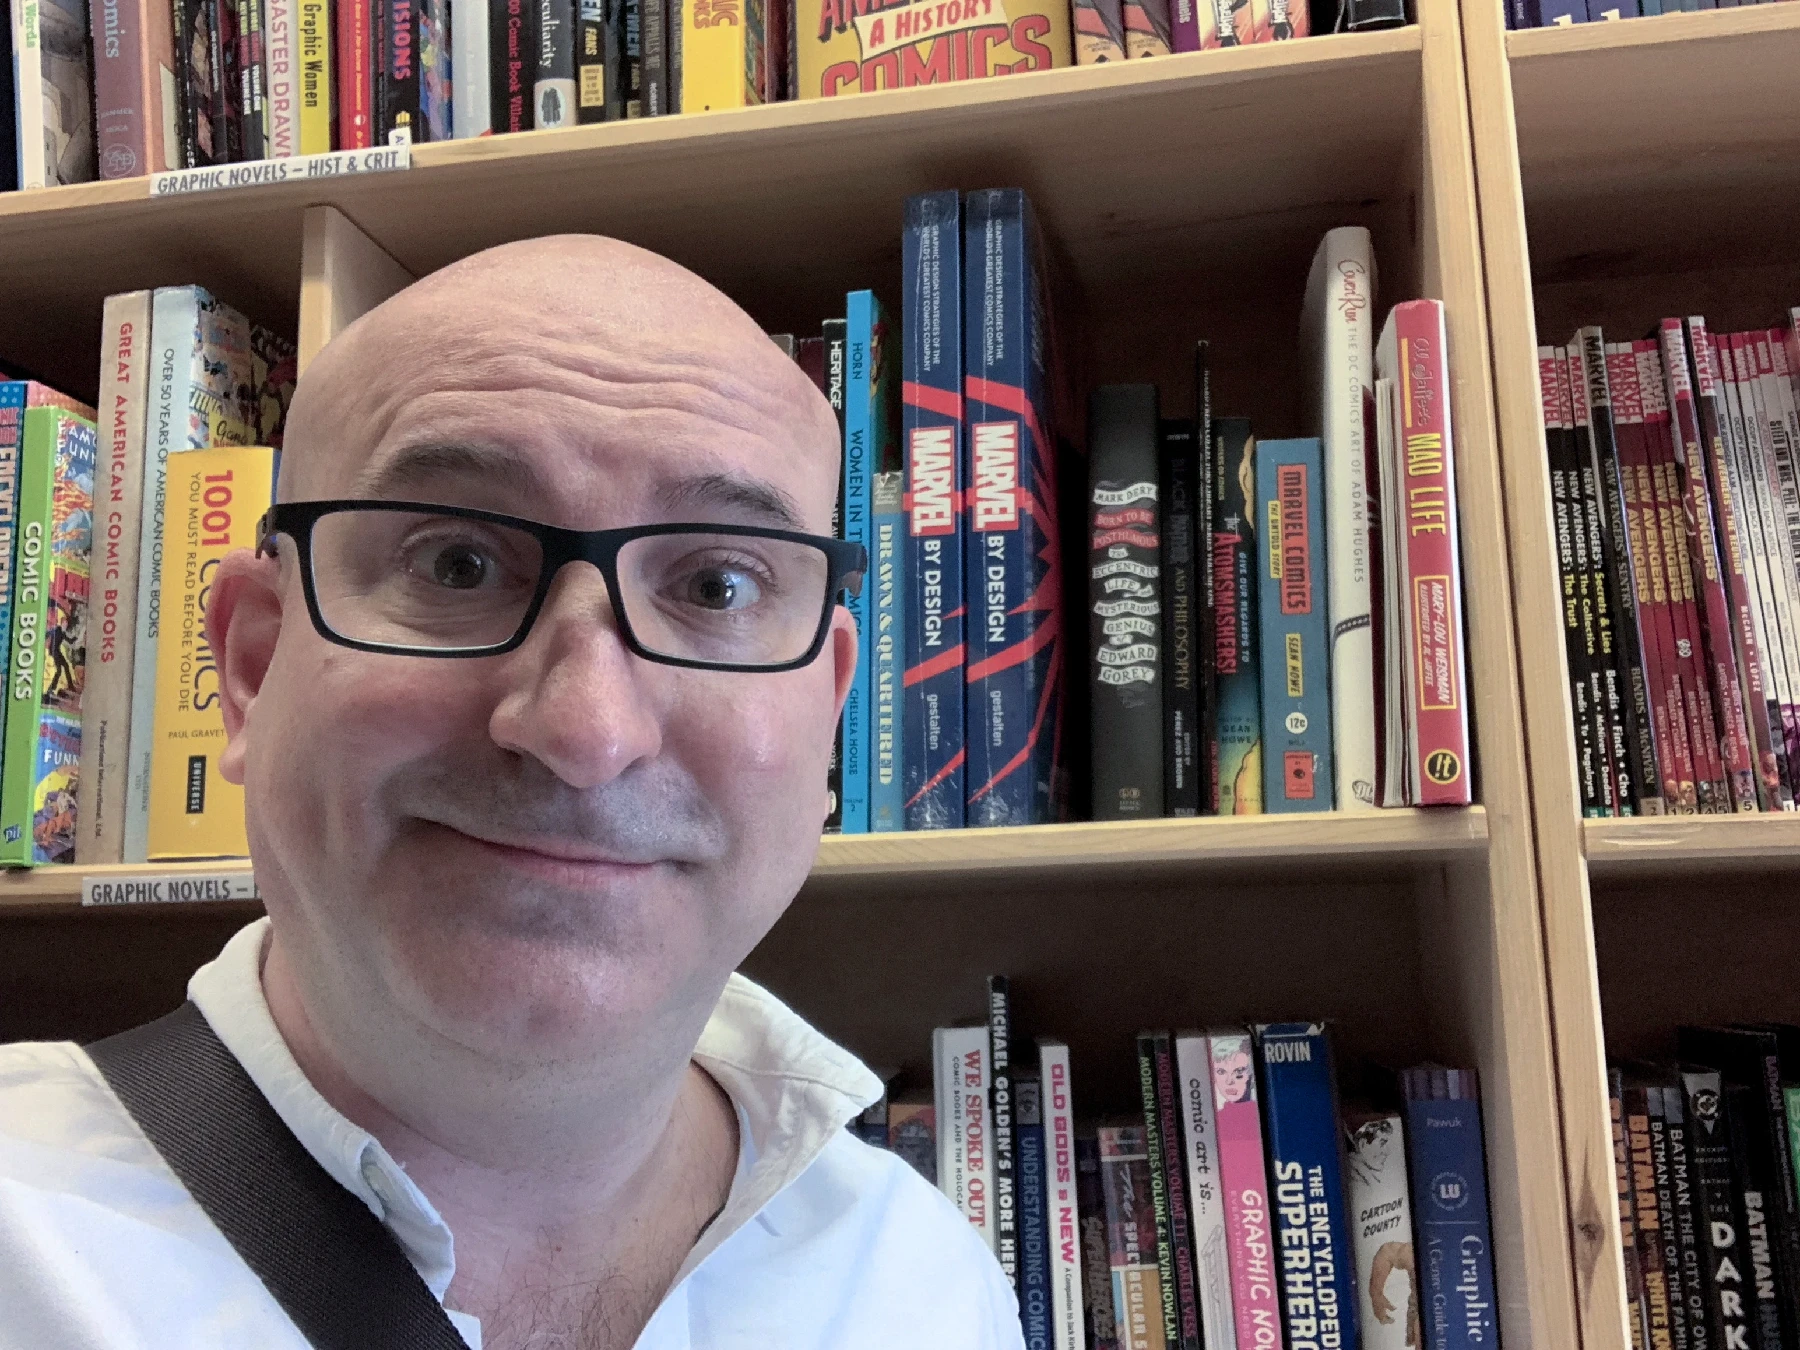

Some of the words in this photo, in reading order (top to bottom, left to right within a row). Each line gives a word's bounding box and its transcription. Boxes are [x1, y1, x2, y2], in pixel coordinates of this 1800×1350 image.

[301, 4, 321, 56] Graphic
[585, 27, 598, 56] FANS
[869, 18, 885, 48] A
[895, 0, 993, 40] HISTORY
[509, 61, 522, 93] Book
[821, 15, 1052, 98] COMICS
[305, 61, 322, 107] Women
[157, 166, 225, 194] GRAPHIC
[229, 162, 287, 186] NOVELS
[307, 157, 343, 177] HIST
[346, 153, 359, 171] &
[363, 150, 400, 170] CRIT
[117, 322, 133, 383] GREAT
[1347, 327, 1358, 348] THE
[163, 348, 175, 381] OVER
[829, 340, 842, 410] HERITAGE
[851, 341, 864, 380] HORN
[1347, 354, 1358, 371] DC
[1583, 334, 1608, 407] MARVEL
[1691, 325, 1715, 394] MARVEL
[160, 385, 173, 400] 50
[1348, 376, 1360, 424] COMICS
[1540, 358, 1558, 426] MARVEL
[1570, 356, 1588, 427] MARVEL
[1665, 330, 1690, 392] MARVEL
[1685, 440, 1703, 480] NEW
[158, 403, 171, 445] YEARS
[1350, 430, 1361, 452] ART
[1620, 353, 1641, 420] MARVEL
[1635, 464, 1650, 502] NEW
[108, 395, 128, 502] AMERICAN
[157, 448, 168, 466] OF
[848, 428, 864, 498] WOMEN
[1350, 459, 1361, 475] OF
[1407, 432, 1443, 478] MAD
[189, 472, 201, 502] YOU
[912, 428, 952, 533] MARVEL
[975, 423, 1015, 529] MARVEL
[1552, 470, 1565, 499] NEW
[1567, 471, 1579, 500] NEW
[1582, 468, 1595, 496] NEW
[1620, 465, 1634, 502] NEW
[1653, 464, 1667, 502] NEW
[152, 470, 167, 540] AMERICAN
[202, 469, 233, 546] 1001
[848, 503, 864, 522] IN
[1283, 470, 1304, 541] MARVEL
[1351, 481, 1362, 521] ADAM
[1409, 486, 1447, 538] LIFE
[187, 508, 200, 547] MUST
[1270, 519, 1279, 551] UNTOLD
[1726, 515, 1738, 530] THE
[21, 521, 43, 604] COMIC
[105, 511, 121, 580] COMIC
[150, 543, 163, 586] COMIC
[879, 523, 893, 609] DRAWN
[924, 540, 941, 565] BY
[987, 534, 1005, 560] BY
[1271, 552, 1280, 577] STORY
[1353, 528, 1364, 583] HUGHES
[1729, 533, 1742, 575] REUNION
[184, 553, 197, 589] READ
[1094, 562, 1157, 578] ECCENTRIC
[1107, 580, 1137, 591] LIFE
[1284, 546, 1307, 610] COMICS
[1564, 575, 1575, 596] The
[1580, 574, 1591, 596] The
[925, 570, 942, 647] DESIGN
[987, 565, 1005, 643] DESIGN
[1420, 584, 1432, 632] ILLUSTRATED
[1430, 581, 1447, 645] MARY-LOU
[1566, 599, 1578, 628] Trust
[1594, 571, 1608, 614] Secrets
[100, 589, 118, 664] BOOKS
[148, 589, 161, 639] BOOKS
[182, 594, 195, 648] BEFORE
[879, 612, 893, 632] &
[1106, 620, 1154, 635] GENIUS
[1581, 599, 1595, 656] Collective
[1599, 617, 1609, 628] &
[1740, 604, 1753, 646] McCANN
[13, 611, 38, 701] BOOKS
[1101, 645, 1156, 664] EDWARD
[1173, 595, 1190, 690] PHILOSOPHY
[1288, 637, 1300, 662] SEAN
[1422, 633, 1431, 645] BY
[1600, 630, 1612, 654] Lies
[180, 653, 192, 684] YOU
[1102, 667, 1147, 684] GOREY
[1289, 666, 1301, 694] HOWE
[1423, 657, 1434, 688] JAFFEE
[1434, 647, 1451, 704] WEISMAN
[1591, 672, 1602, 703] Bendis
[1605, 668, 1619, 710] Bendis
[178, 689, 190, 712] DIE
[848, 688, 860, 736] CHELSEA
[876, 634, 893, 786] QUARTERED
[989, 690, 1004, 747] gestalten
[1577, 682, 1586, 713] Bendis
[169, 731, 188, 739] PAUL
[927, 694, 941, 751] gestalten
[1595, 714, 1607, 755] McNiven
[1611, 725, 1624, 758] Finch
[848, 739, 859, 776] HOUSE
[1581, 747, 1595, 798] Pagulayan
[191, 761, 202, 810] UNIVERSE
[1601, 766, 1612, 805] Deodato
[1618, 773, 1629, 798] Cho
[91, 882, 162, 903] GRAPHIC
[168, 880, 230, 900] NOVELS
[991, 992, 1009, 1070] MICHAEL
[1264, 1041, 1311, 1063] ROVIN
[951, 1056, 961, 1087] COMIC
[964, 1049, 982, 1088] WE
[1051, 1063, 1067, 1110] OLD
[1139, 1056, 1154, 1109] MODERN
[1189, 1078, 1212, 1133] comic
[953, 1123, 962, 1143] AND
[965, 1093, 985, 1173] SPOKE
[1053, 1115, 1071, 1183] GODS
[1144, 1111, 1161, 1169] MASTERS
[1652, 1122, 1668, 1185] BATMAN
[954, 1147, 963, 1165] THE
[1195, 1141, 1212, 1174] art
[1628, 1115, 1659, 1230] BATMAN
[1669, 1129, 1691, 1206] BATMAN
[967, 1177, 987, 1228] OUT
[1151, 1170, 1167, 1224] VOLUME
[1308, 1165, 1325, 1198] THE
[998, 1177, 1014, 1232] MORE
[1021, 1136, 1044, 1286] UNDERSTANDING
[1360, 1197, 1403, 1222] CARTOON
[1659, 1190, 1675, 1240] DEATH
[1059, 1206, 1075, 1264] NEW
[1241, 1189, 1270, 1301] GRAPHIC
[1362, 1215, 1402, 1239] COUNTY
[1680, 1213, 1695, 1244] THE
[1744, 1191, 1775, 1299] BATMAN
[1158, 1241, 1173, 1281] KEVIN
[1664, 1246, 1677, 1266] OF
[1683, 1250, 1699, 1288] CITY
[1456, 1235, 1489, 1342] Graphic
[1668, 1271, 1681, 1300] THE
[1711, 1221, 1749, 1350] DARK
[1161, 1284, 1178, 1340] NOWLAN
[1688, 1296, 1704, 1319] OF
